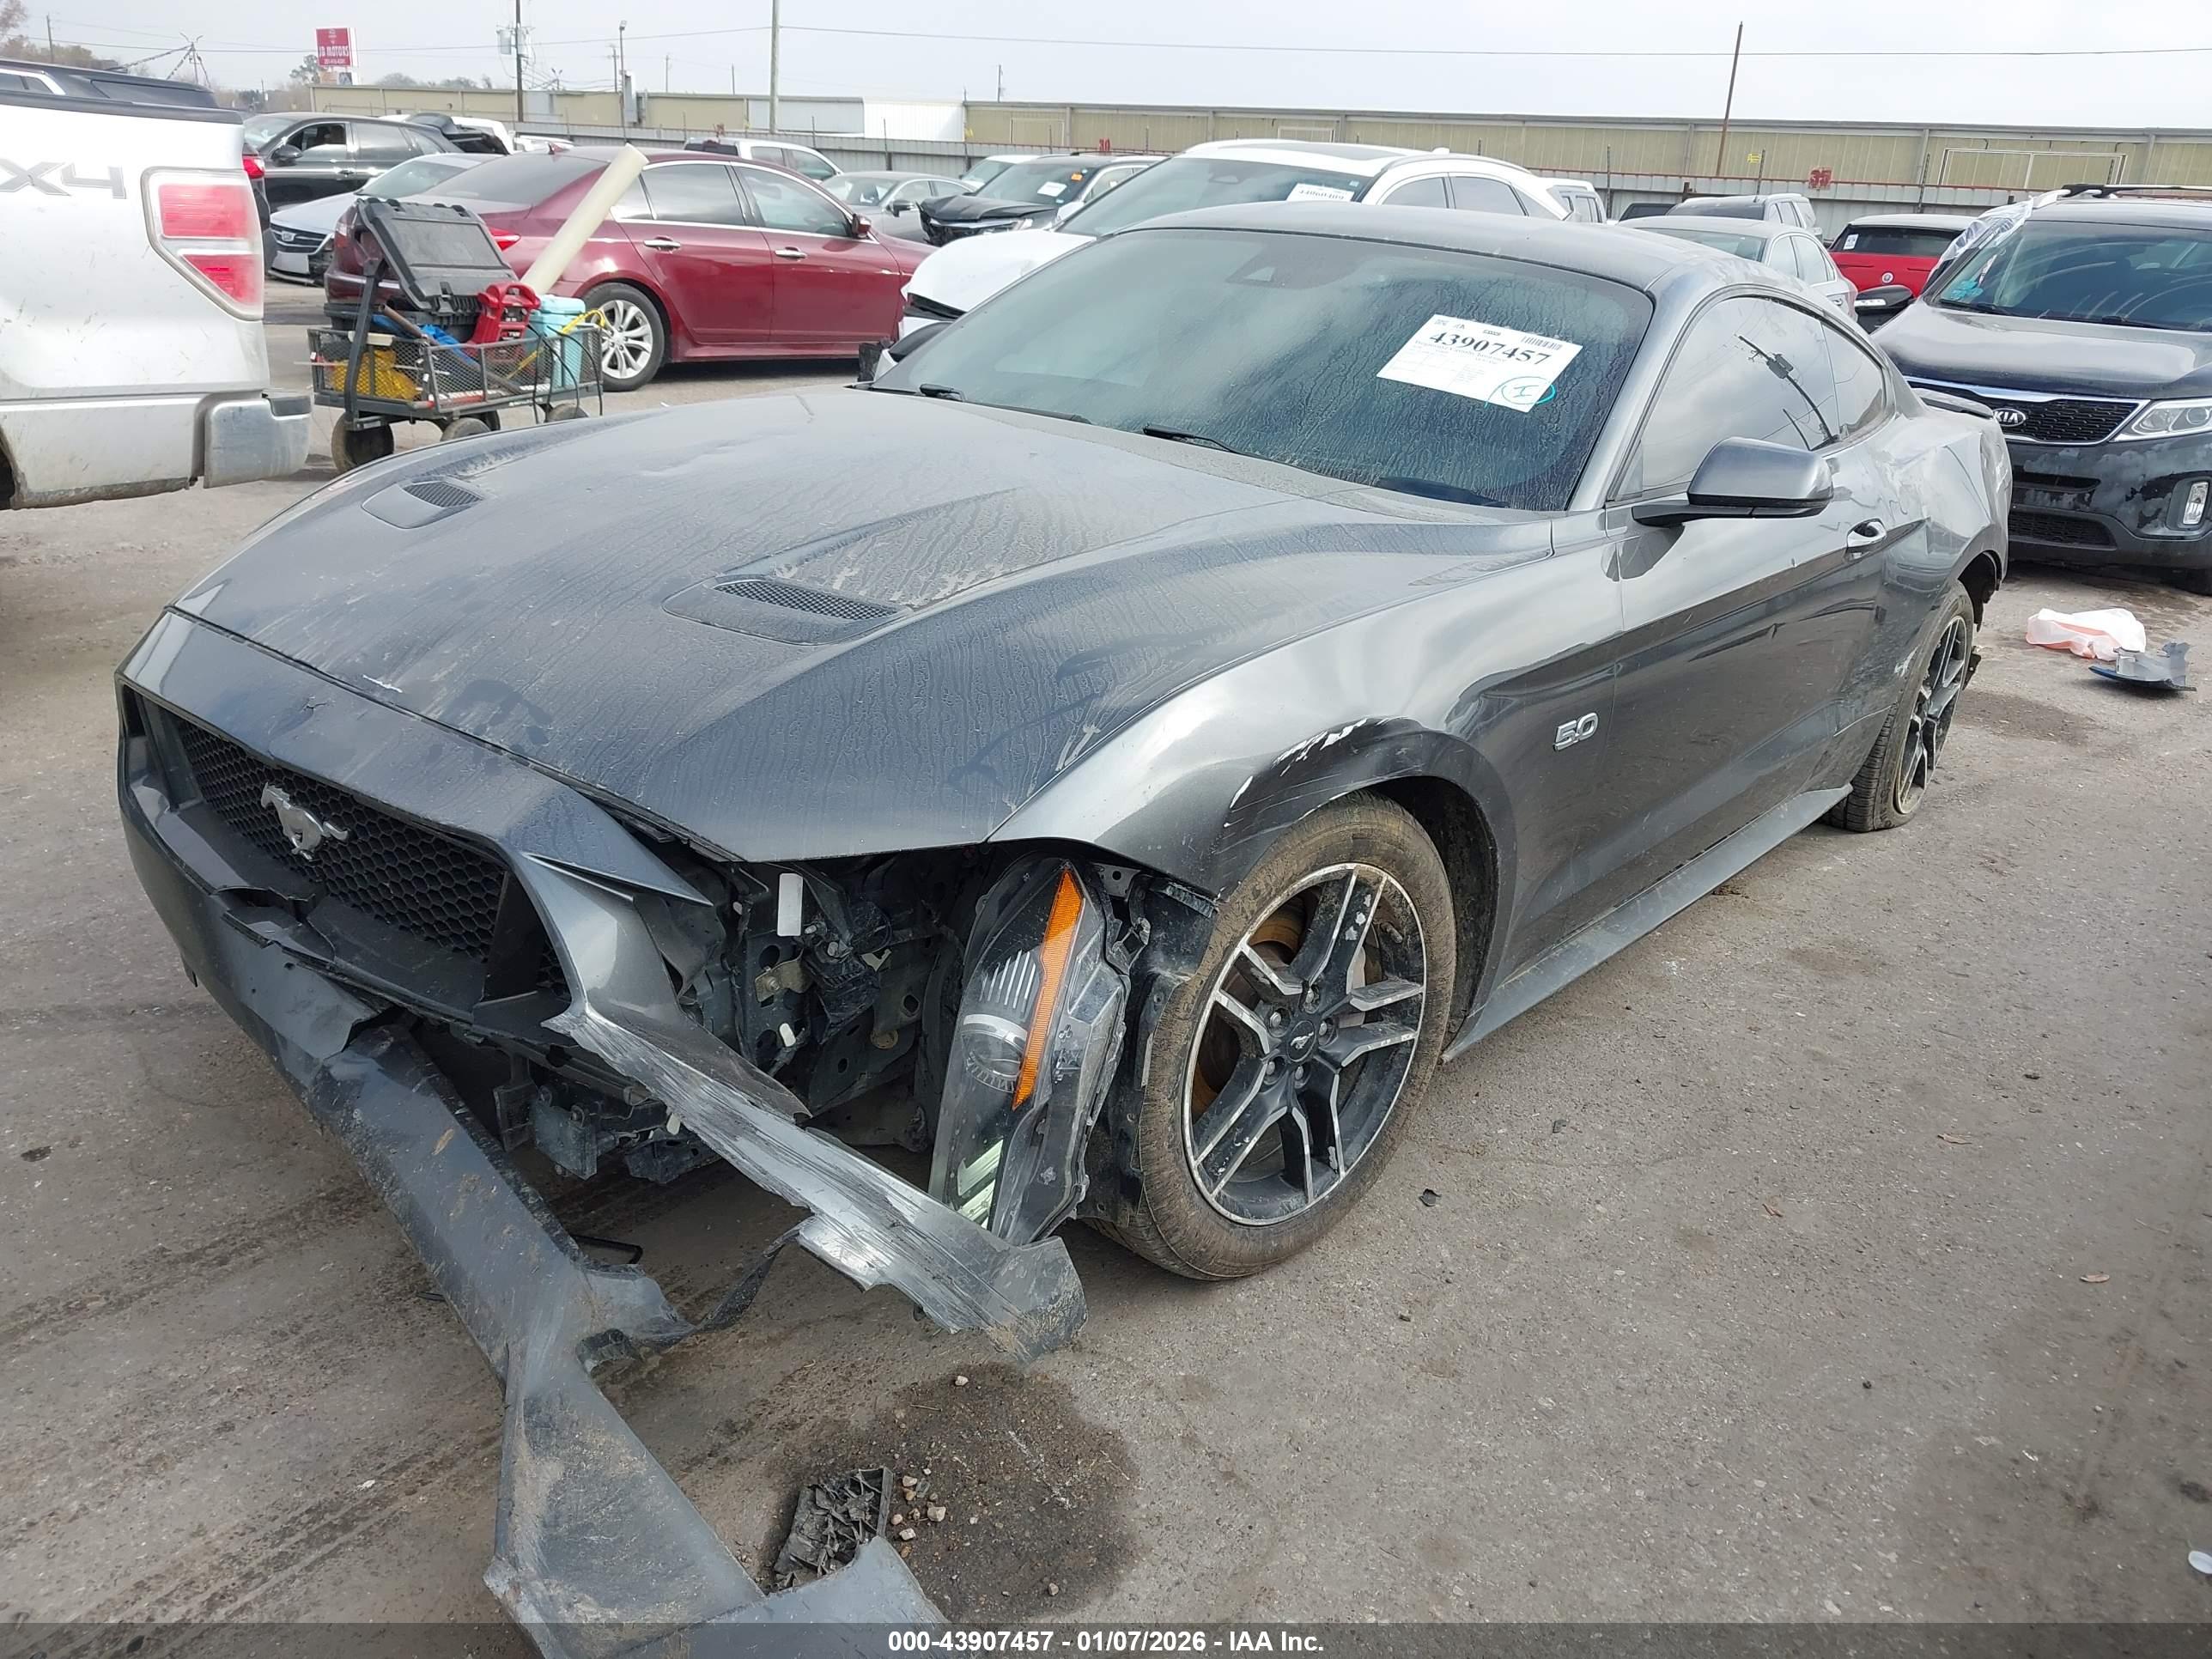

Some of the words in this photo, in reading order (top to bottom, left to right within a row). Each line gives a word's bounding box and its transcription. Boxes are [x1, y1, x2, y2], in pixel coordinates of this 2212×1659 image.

[326, 46, 349, 57] MOTORS
[1430, 331, 1552, 365] 43907457
[1993, 410, 2019, 423] KIA
